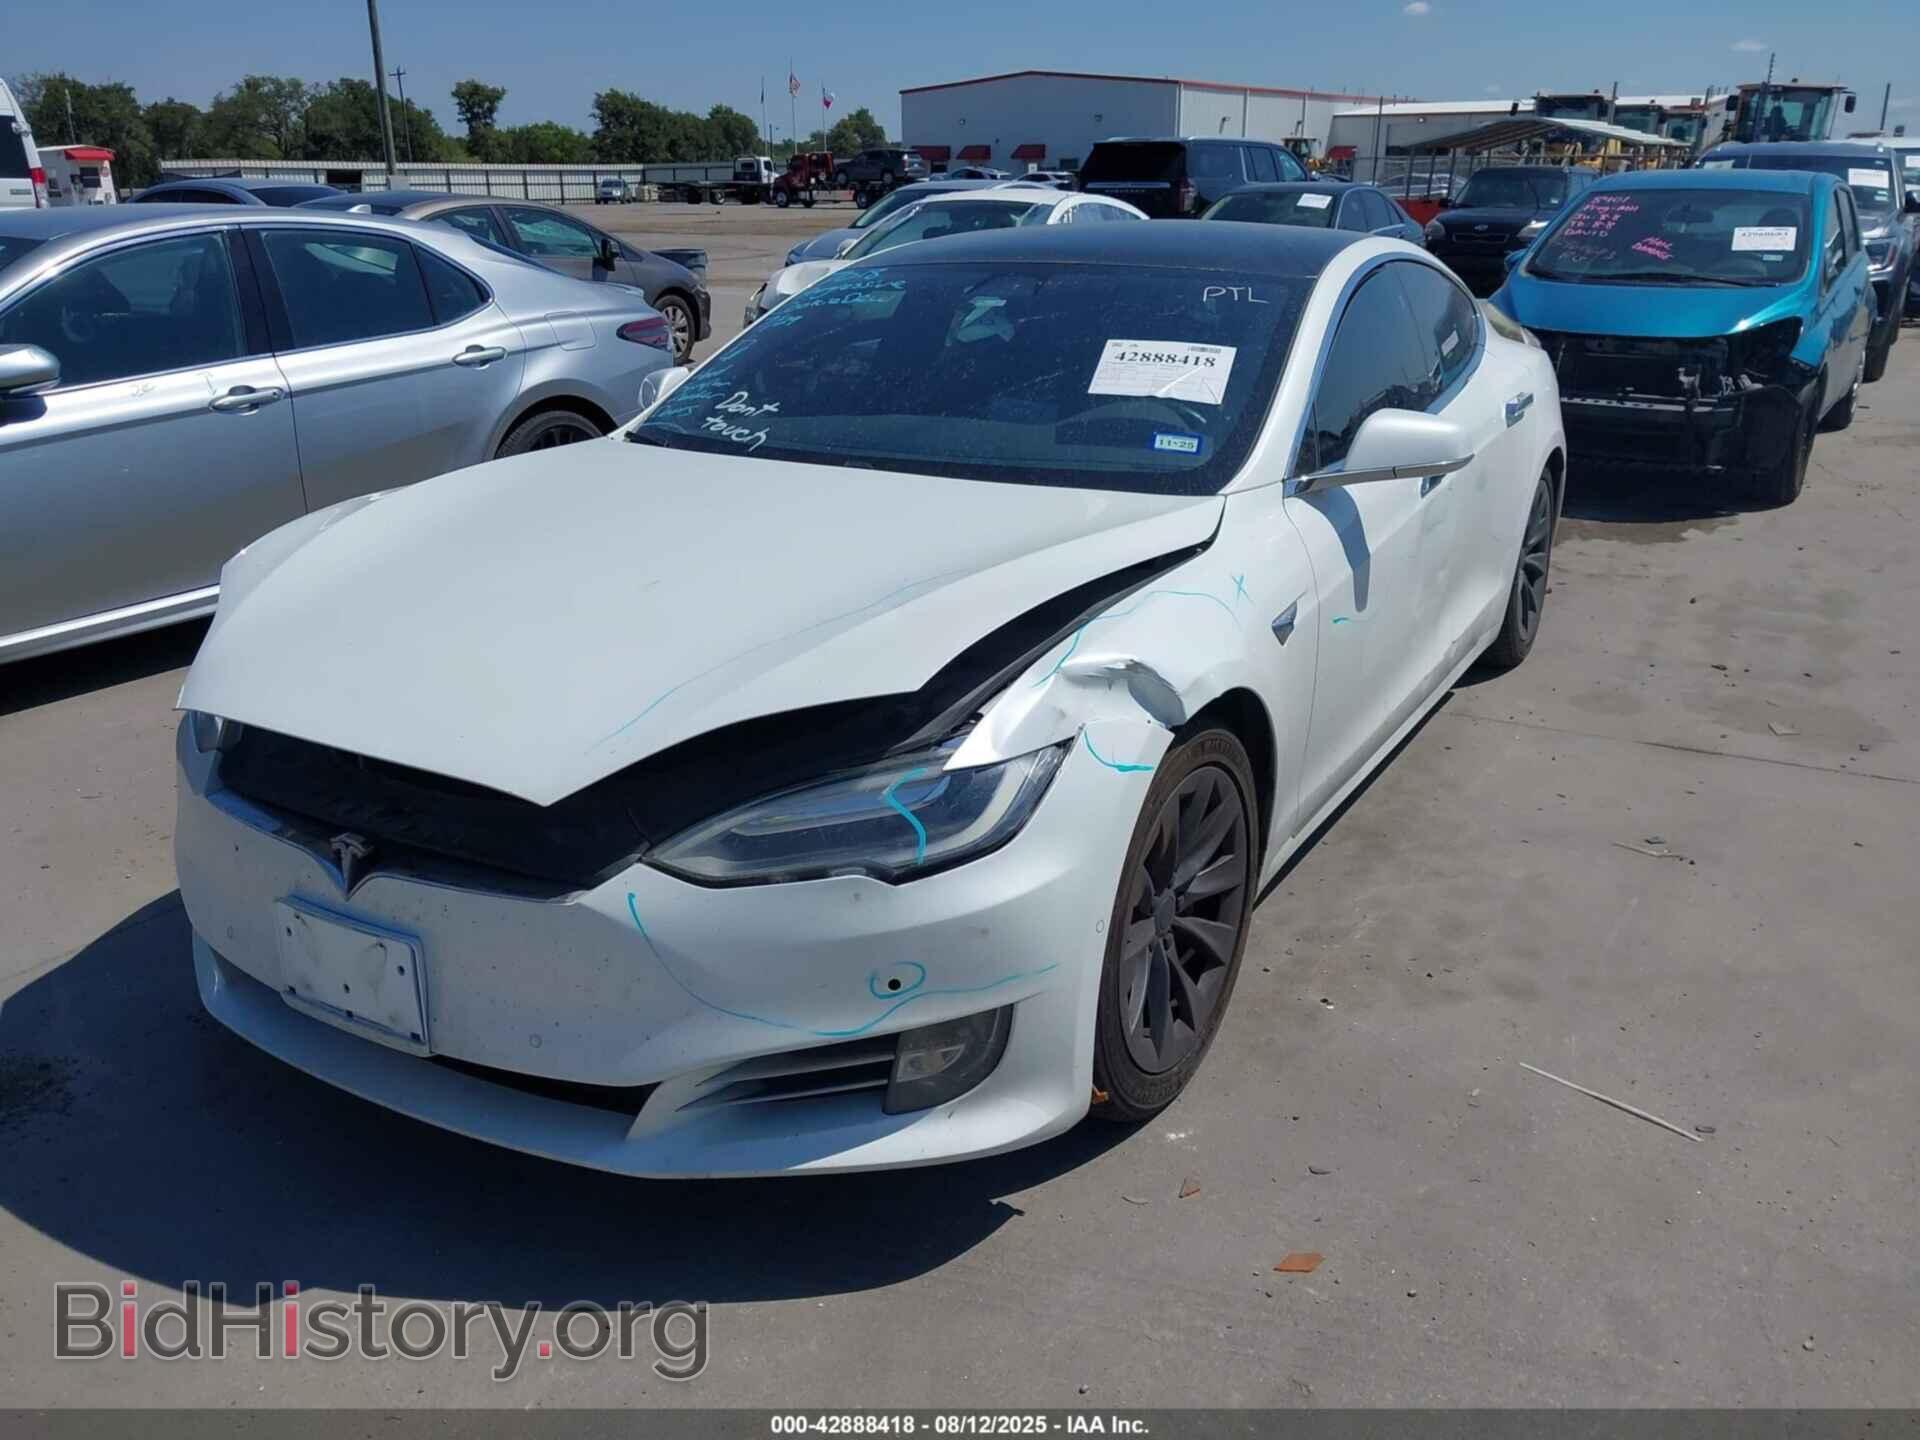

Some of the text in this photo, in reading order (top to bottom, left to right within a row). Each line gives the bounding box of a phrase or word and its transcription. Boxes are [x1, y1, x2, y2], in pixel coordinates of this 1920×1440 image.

[1202, 286, 1271, 304] PTL
[1114, 351, 1217, 368] 42888418
[700, 415, 769, 452] touch
